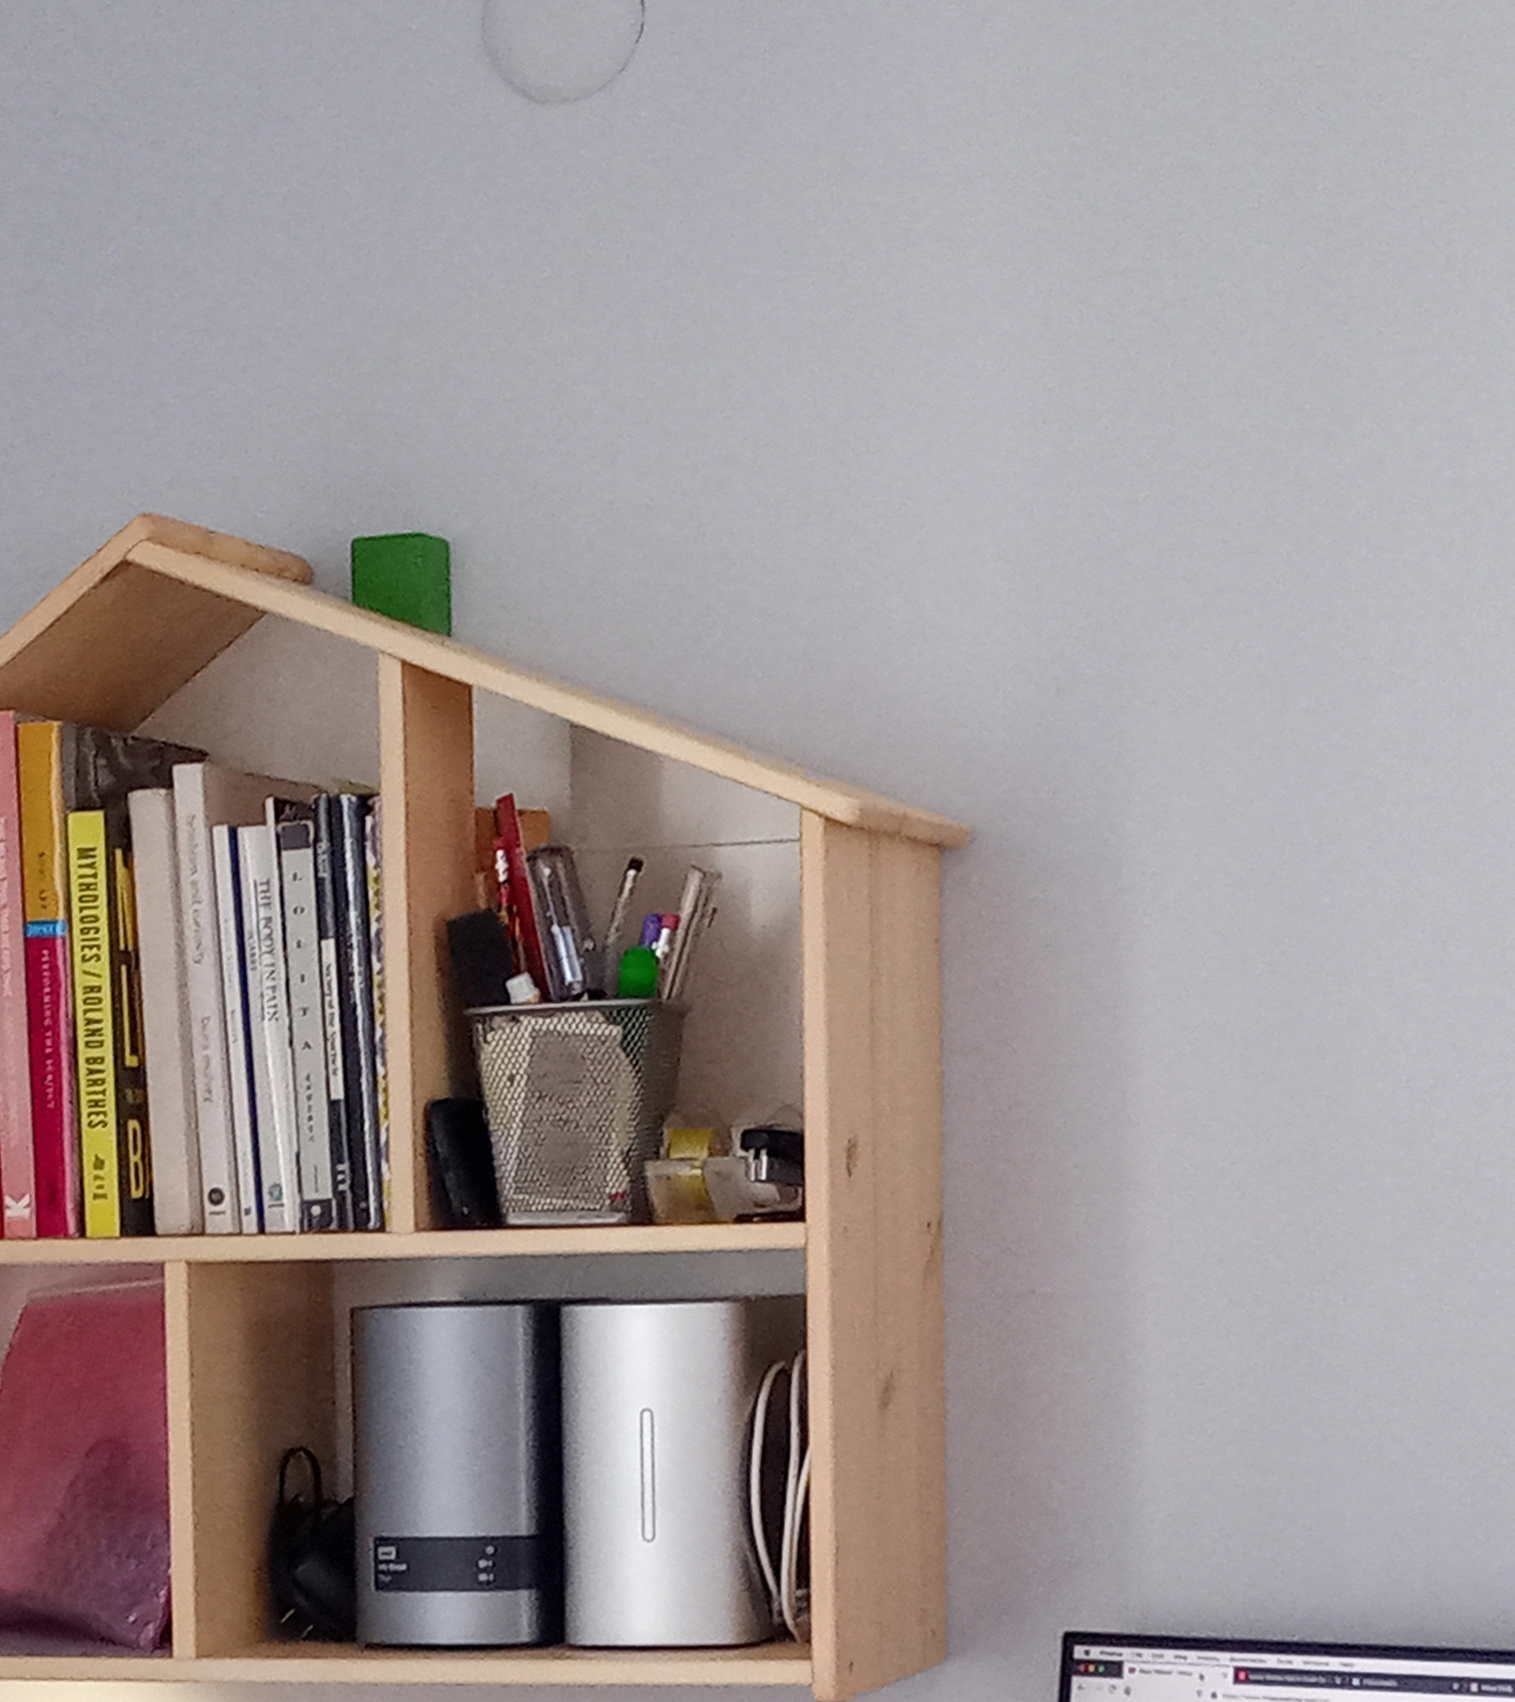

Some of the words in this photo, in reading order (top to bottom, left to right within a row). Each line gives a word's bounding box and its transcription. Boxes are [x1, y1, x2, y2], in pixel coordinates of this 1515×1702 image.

[76, 846, 102, 965] MYTHOLOGIES
[257, 877, 272, 908] THE
[259, 916, 275, 958] BODY
[262, 962, 277, 982] IN
[82, 984, 105, 1050] ROLAND
[265, 985, 280, 1022] PAIN
[85, 1055, 107, 1130] BARTHES
